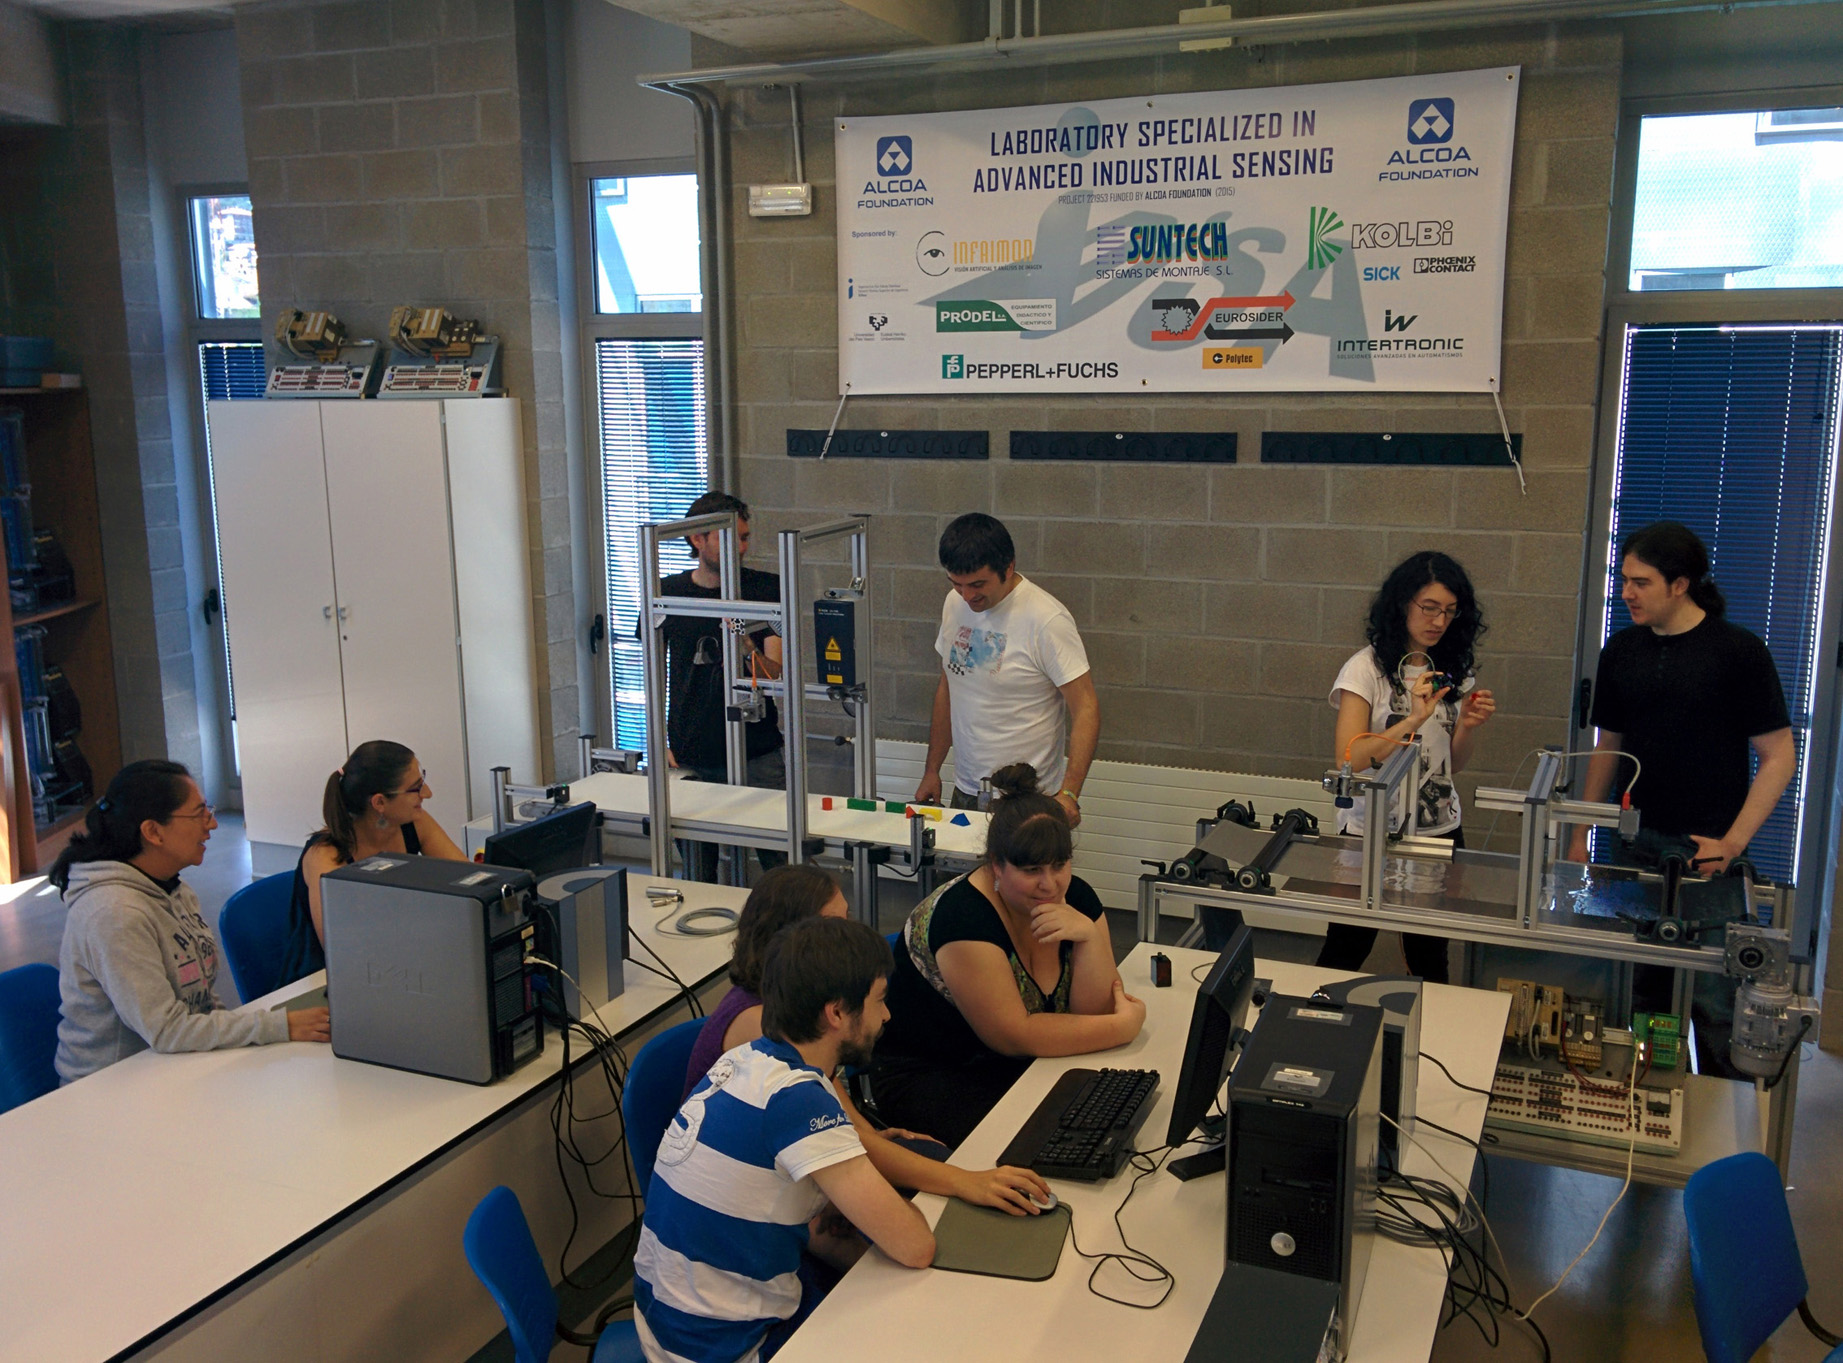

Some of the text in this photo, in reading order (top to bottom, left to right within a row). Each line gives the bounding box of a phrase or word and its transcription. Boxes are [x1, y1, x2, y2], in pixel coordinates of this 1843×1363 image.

[991, 110, 1316, 156] LABORATORY SPECIALIZED IN
[1386, 146, 1472, 165] ALCOA
[973, 147, 1333, 192] ADVANCED INDUSTRIAL SENSING
[1379, 167, 1479, 181] FOUNDATION
[863, 178, 927, 194] ALCOA
[857, 197, 934, 208] FOUNDATION
[1058, 194, 1085, 205] PROJECT
[1110, 192, 1133, 202] FUNDED
[1135, 192, 1143, 201] BY
[1145, 190, 1167, 201] ALCOA
[1168, 188, 1212, 199] FOUNDATION
[1215, 187, 1236, 197] (2015)
[851, 230, 886, 240] Sponsored
[1127, 222, 1229, 264] SUNTECH
[954, 239, 1033, 264] INFAIMON
[1096, 265, 1234, 280] SISTEMAS DE MONTAJE S.L.
[1363, 266, 1401, 281] SICK
[1429, 264, 1476, 273] CONTACT
[940, 310, 1006, 322] PRODEL
[1215, 312, 1284, 323] EUROSIDER
[1337, 338, 1464, 352] INTERTRONIC
[1225, 354, 1253, 364] Polytec
[966, 362, 1119, 379] PEPPERL+FUCHS
